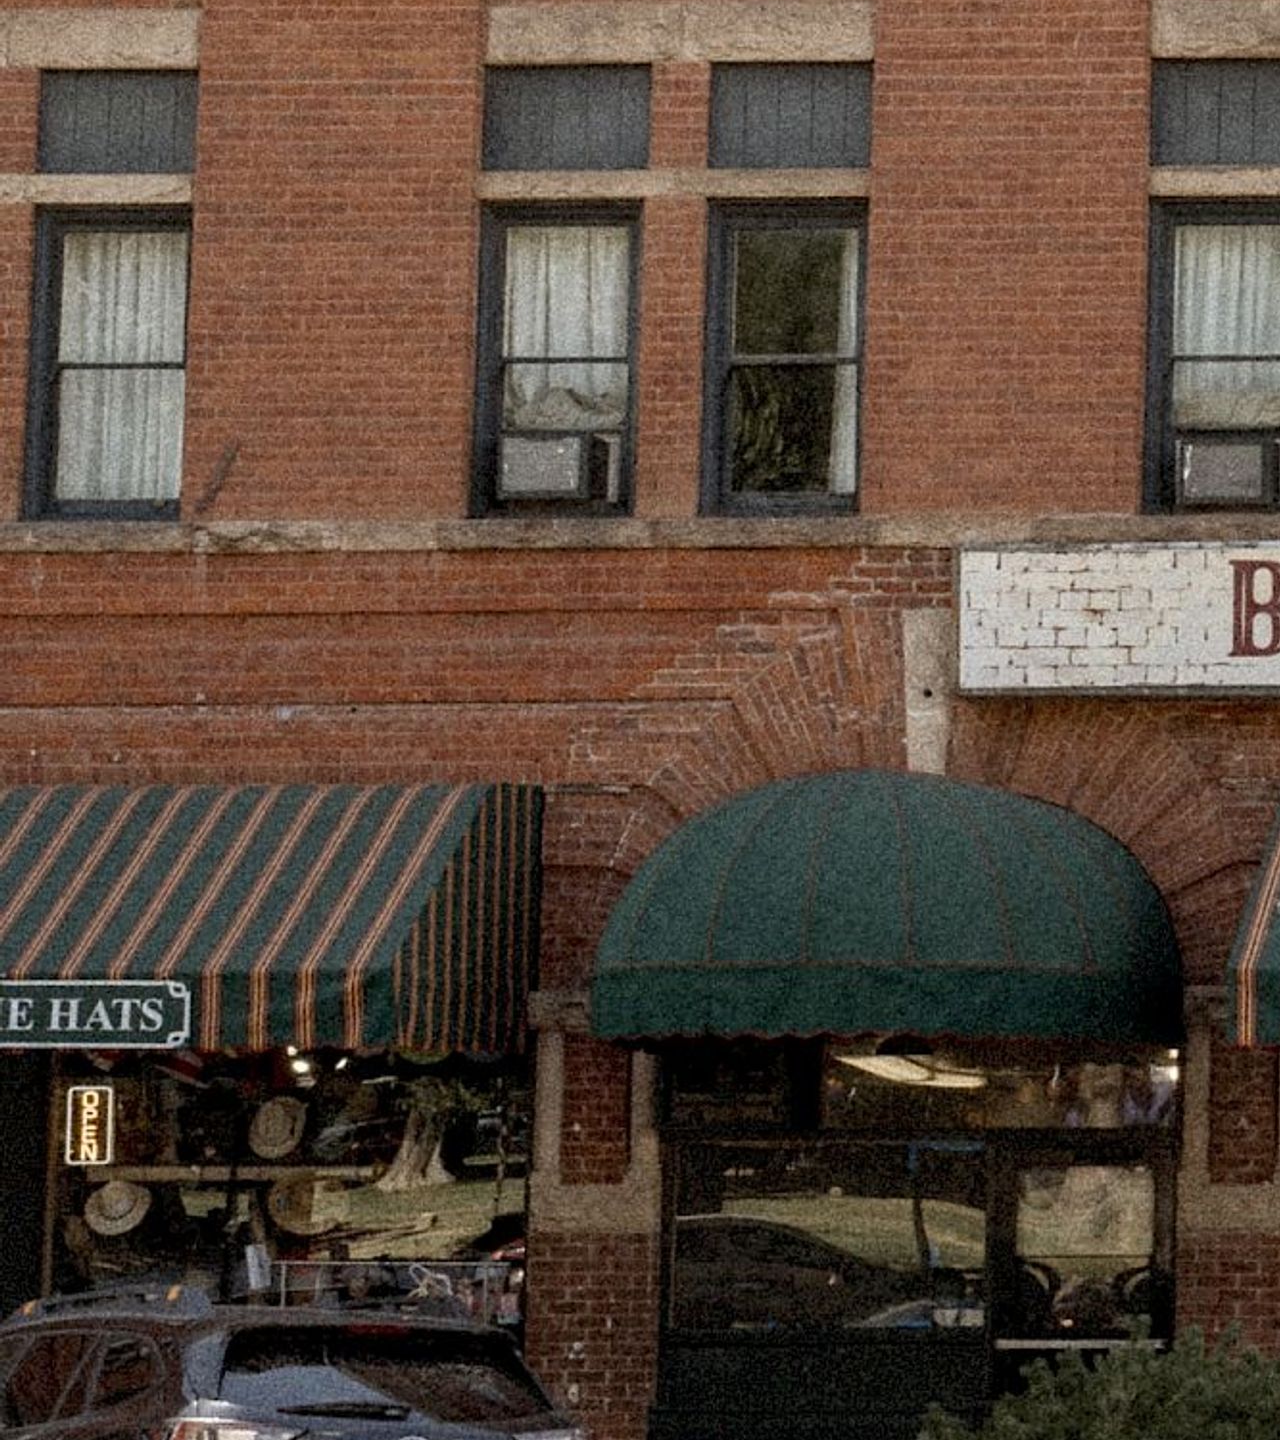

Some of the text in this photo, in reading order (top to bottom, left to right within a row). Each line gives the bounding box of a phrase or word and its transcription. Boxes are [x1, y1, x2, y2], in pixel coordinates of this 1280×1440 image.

[0, 997, 164, 1031] E HATS
[80, 1090, 99, 1161] OPEN
